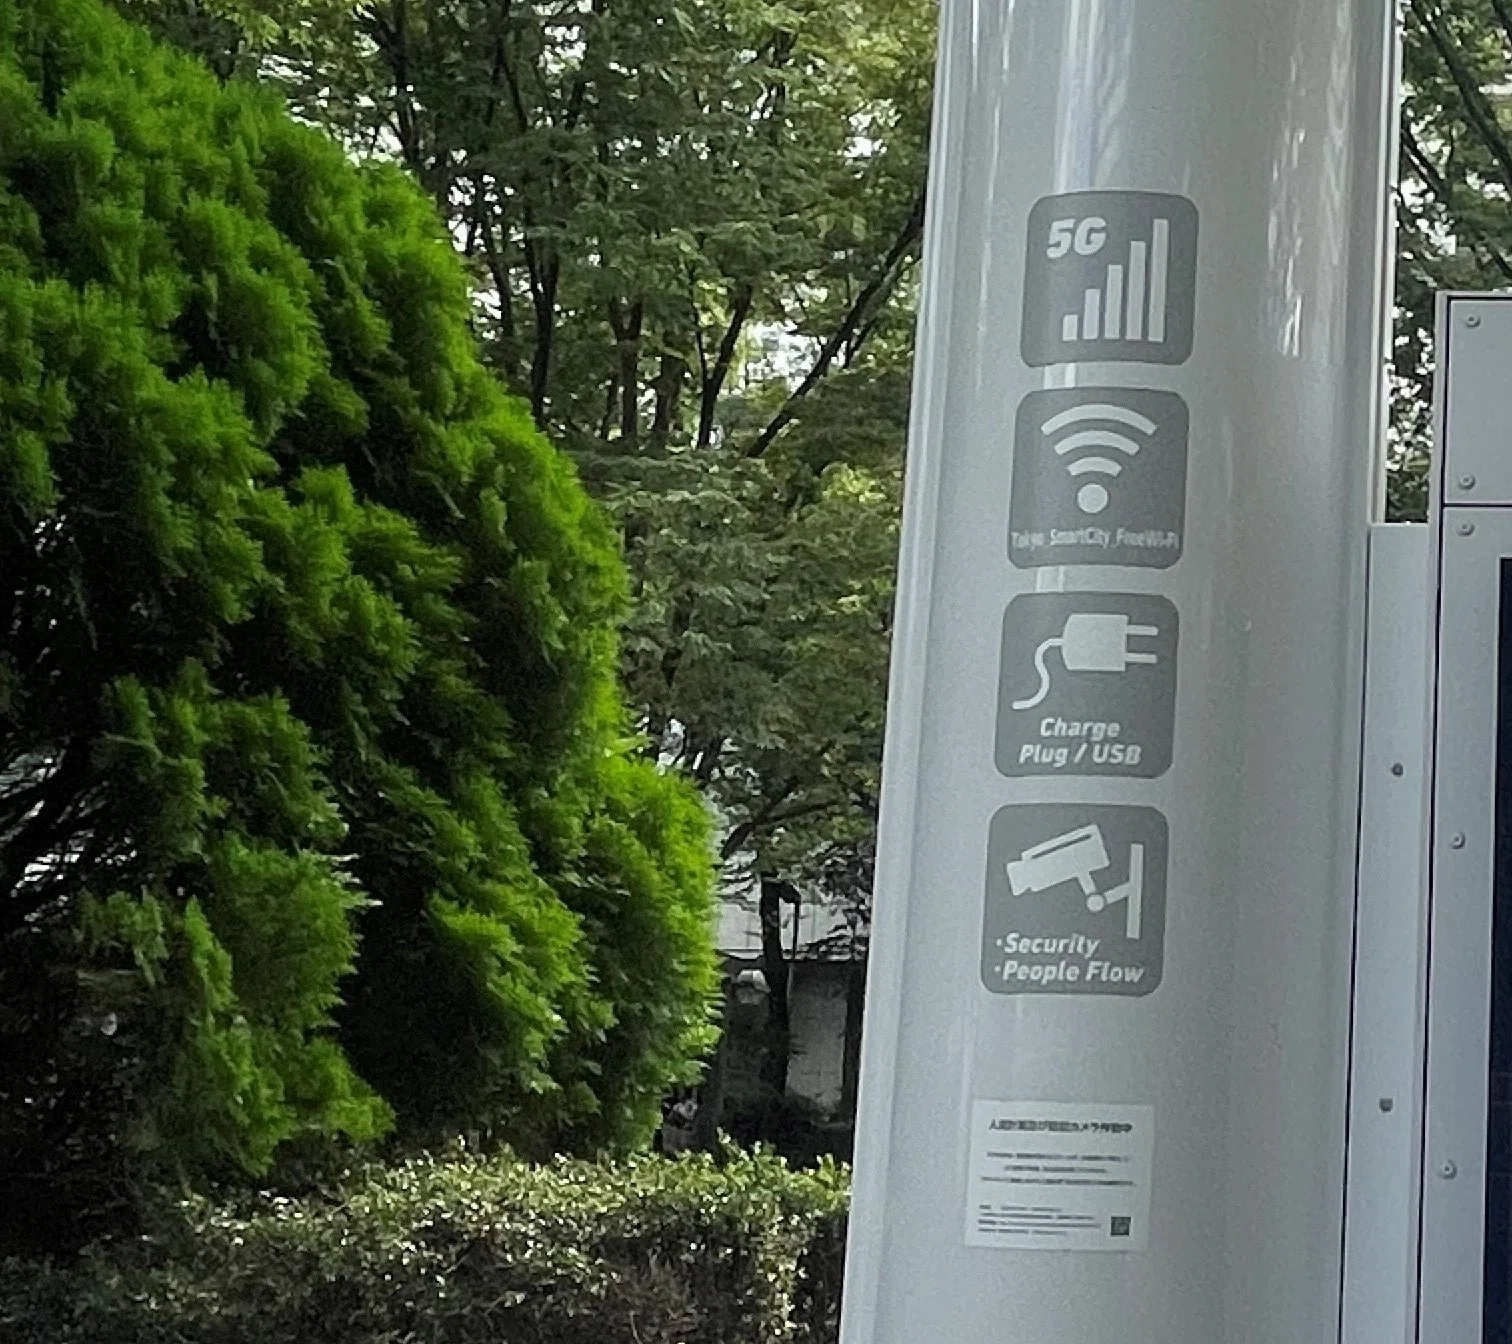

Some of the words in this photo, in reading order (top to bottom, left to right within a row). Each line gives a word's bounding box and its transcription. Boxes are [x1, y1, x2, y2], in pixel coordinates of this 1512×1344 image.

[1046, 217, 1106, 259] 5G
[1039, 717, 1122, 741] Charge
[1019, 744, 1069, 767] Plug
[1073, 743, 1088, 764] /
[1092, 744, 1143, 765] USB
[1085, 961, 1146, 983] Flow
